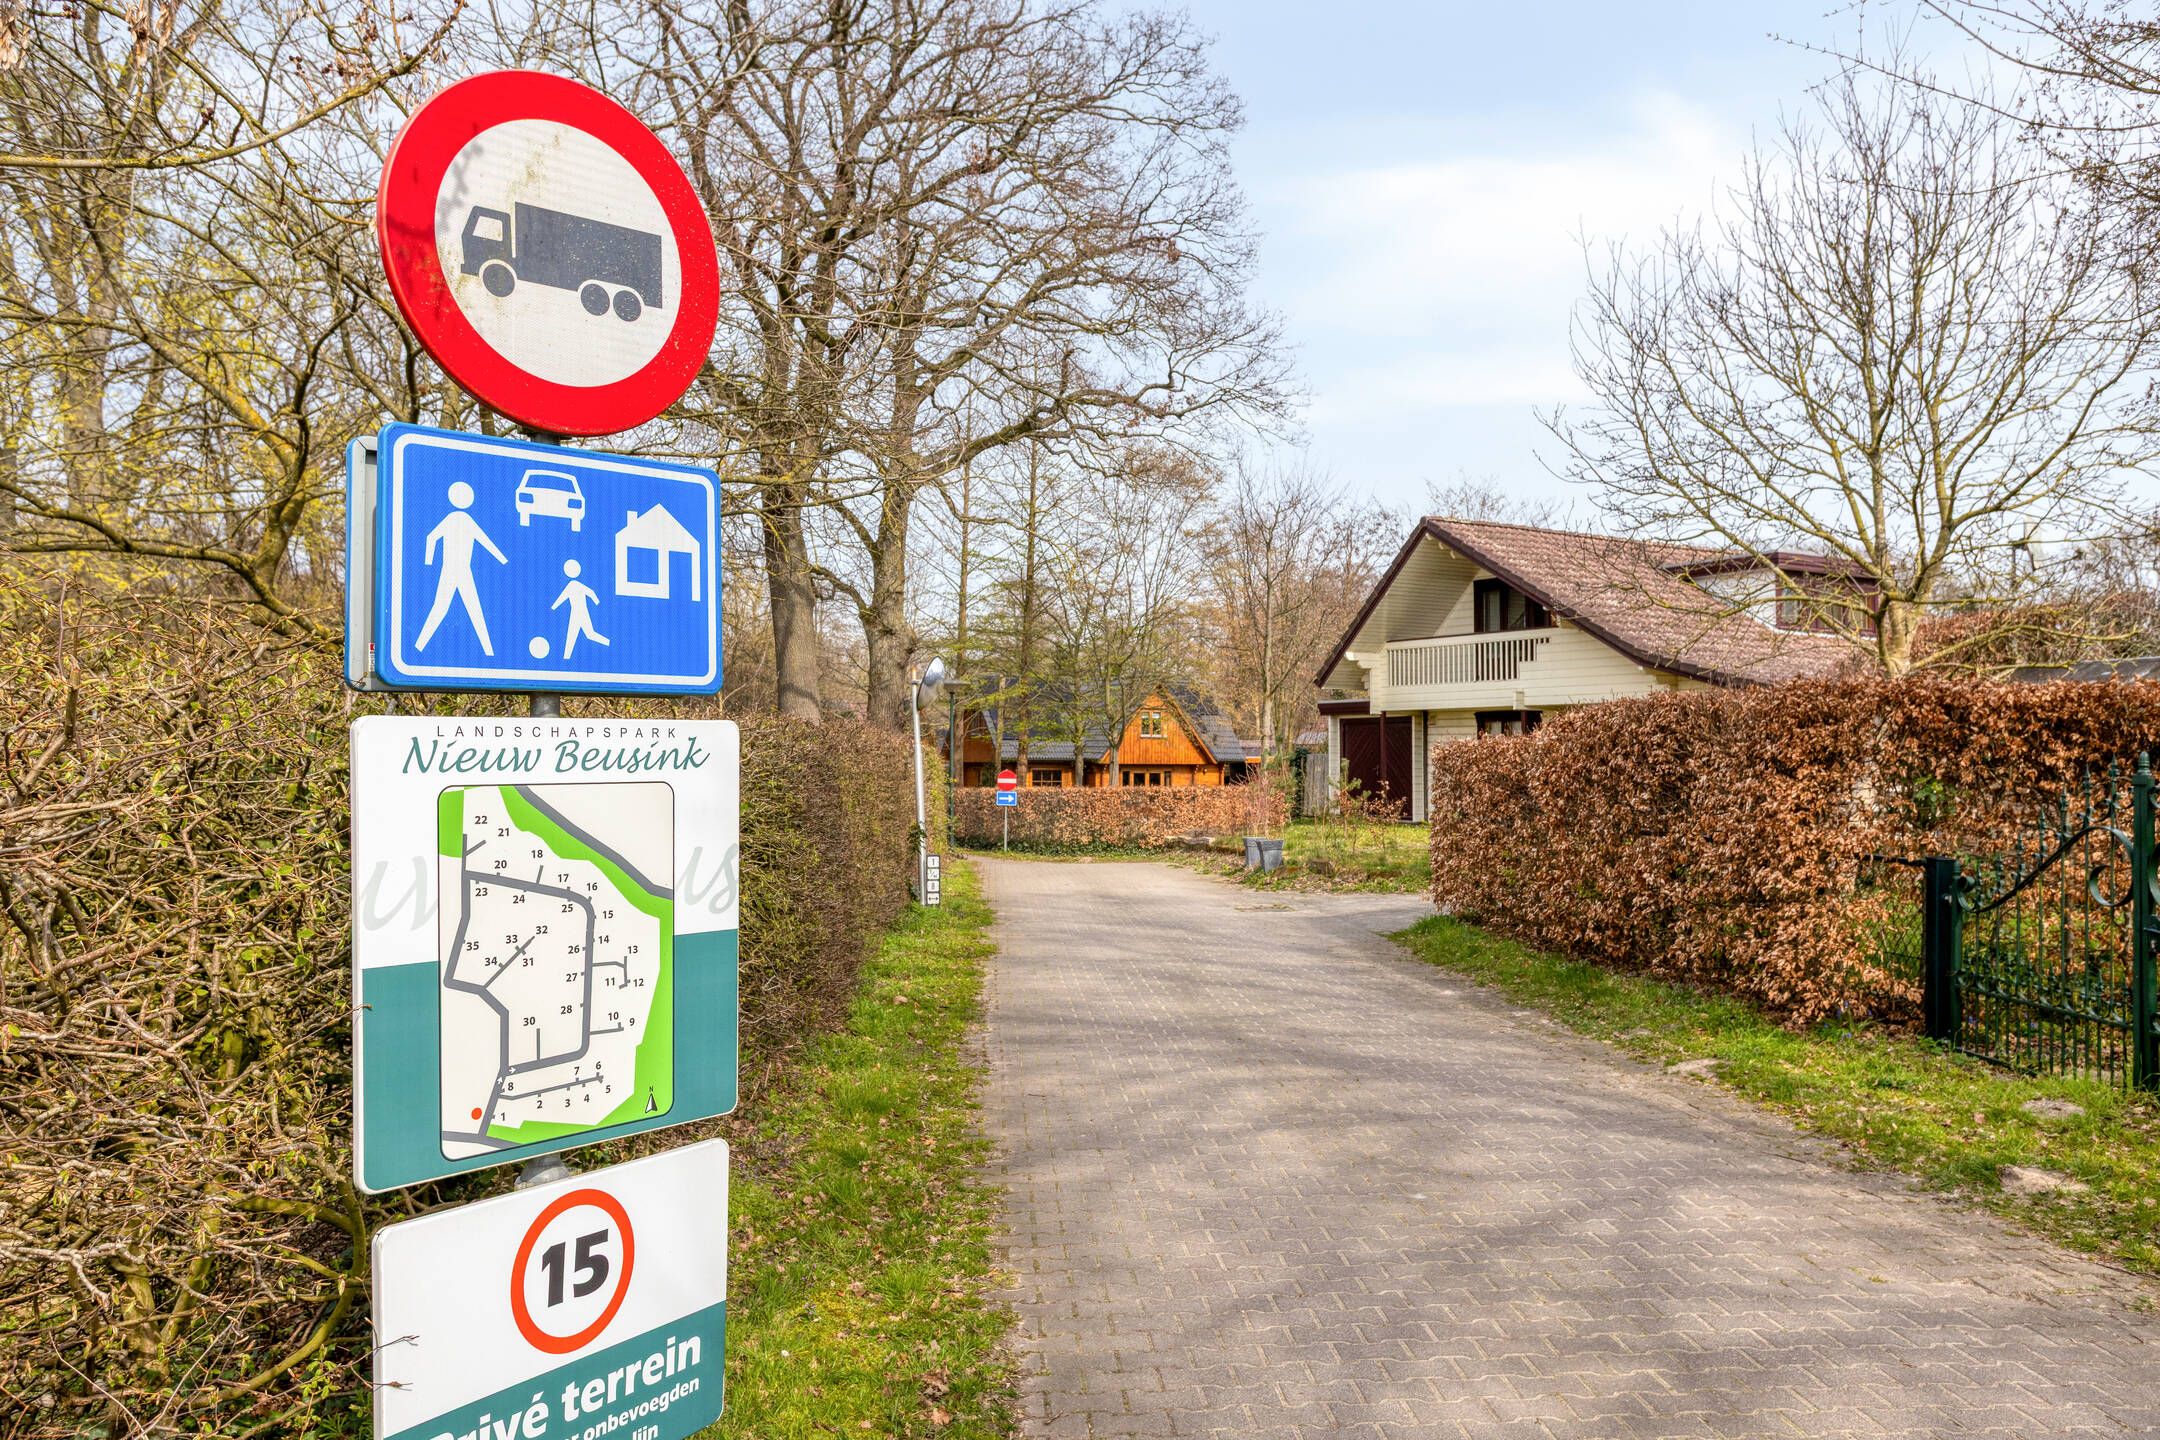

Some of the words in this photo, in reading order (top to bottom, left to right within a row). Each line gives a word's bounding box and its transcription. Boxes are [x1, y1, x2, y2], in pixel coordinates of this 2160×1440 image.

[437, 725, 676, 739] LANDSCHAPSPARK
[402, 736, 542, 774] Nieuw
[554, 736, 711, 773] Beusink
[474, 815, 488, 825] 22
[497, 827, 510, 837] 21
[531, 849, 544, 859] 18
[494, 860, 508, 869] 20
[557, 873, 569, 883] 17
[475, 887, 488, 897] 23
[586, 882, 598, 892] 16
[512, 895, 526, 904] 24
[561, 904, 574, 913] 25
[602, 910, 614, 920] 15
[535, 925, 548, 934] 32
[505, 934, 518, 944] 33
[598, 934, 610, 945] 14
[466, 941, 480, 951] 35
[568, 945, 580, 954] 26
[627, 945, 639, 954] 13
[484, 956, 497, 966] 34
[522, 957, 534, 967] 31
[566, 972, 578, 983] 27
[605, 977, 615, 987] 11
[633, 978, 644, 988] 12
[560, 1004, 573, 1015] 28
[523, 1016, 536, 1026] 30
[608, 1012, 619, 1021] 10
[629, 1017, 635, 1027] 9
[595, 1061, 602, 1070] 6
[574, 1066, 580, 1076] 7
[507, 1081, 514, 1091] 8
[605, 1084, 611, 1094] 5
[564, 1098, 571, 1108] 3
[583, 1093, 590, 1103] 4
[536, 1099, 543, 1109] 2
[500, 1112, 506, 1122] 1
[541, 1228, 610, 1308] 15
[429, 1391, 549, 1440] ivé
[561, 1335, 701, 1422] terrein
[583, 1377, 700, 1440] onbevoegden
